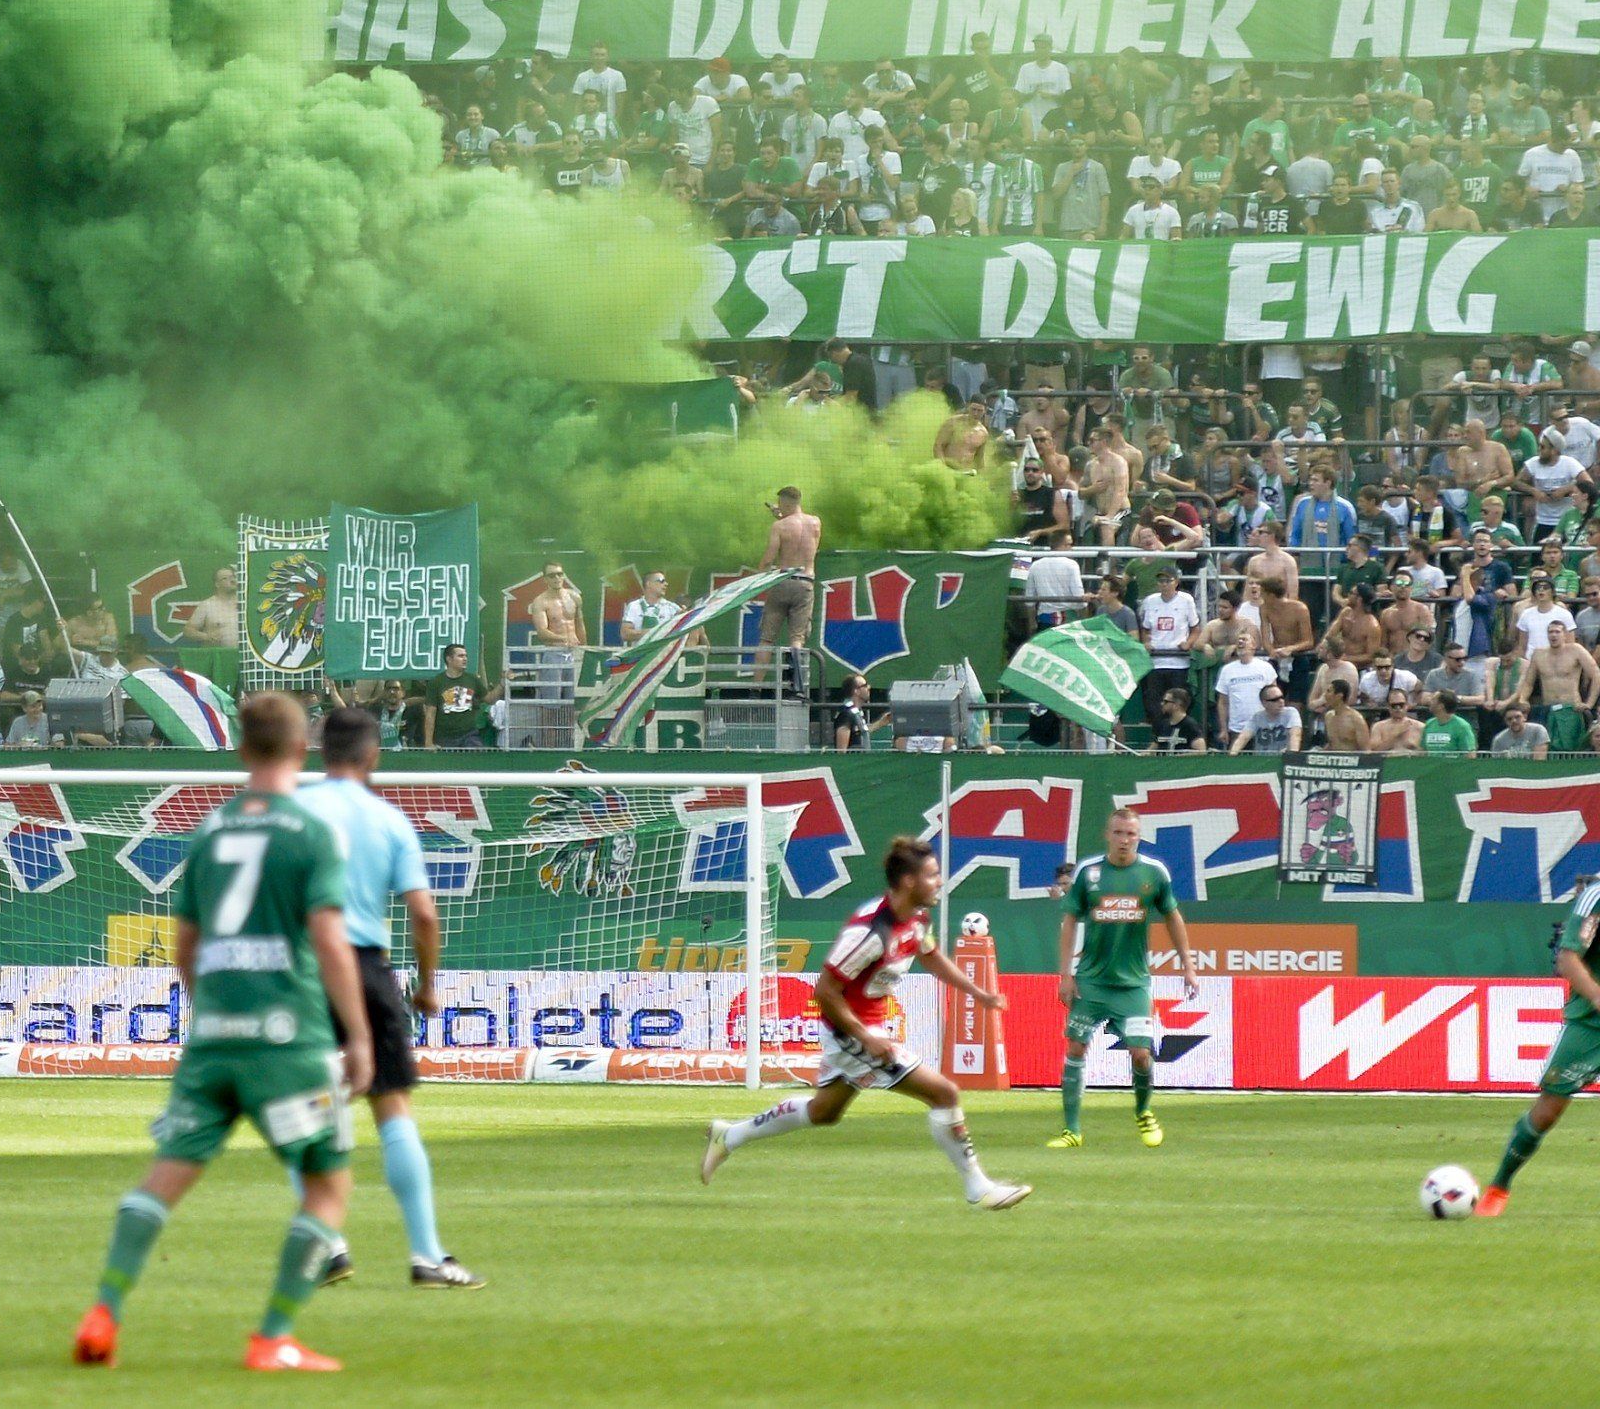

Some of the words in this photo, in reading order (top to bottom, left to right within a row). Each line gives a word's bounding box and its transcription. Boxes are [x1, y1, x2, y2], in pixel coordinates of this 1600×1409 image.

[979, 242, 1150, 339] DU
[1224, 235, 1508, 341] EWIG
[346, 514, 416, 569] WIR
[336, 564, 469, 622] HASSEN
[212, 832, 270, 936] 7
[1289, 870, 1322, 882] MIT
[1327, 872, 1366, 884] UNS!
[1103, 897, 1139, 909] WIEN
[1226, 949, 1344, 973] ENERGIE
[32, 1047, 106, 1062] WIEN
[619, 1054, 696, 1068] WIEN
